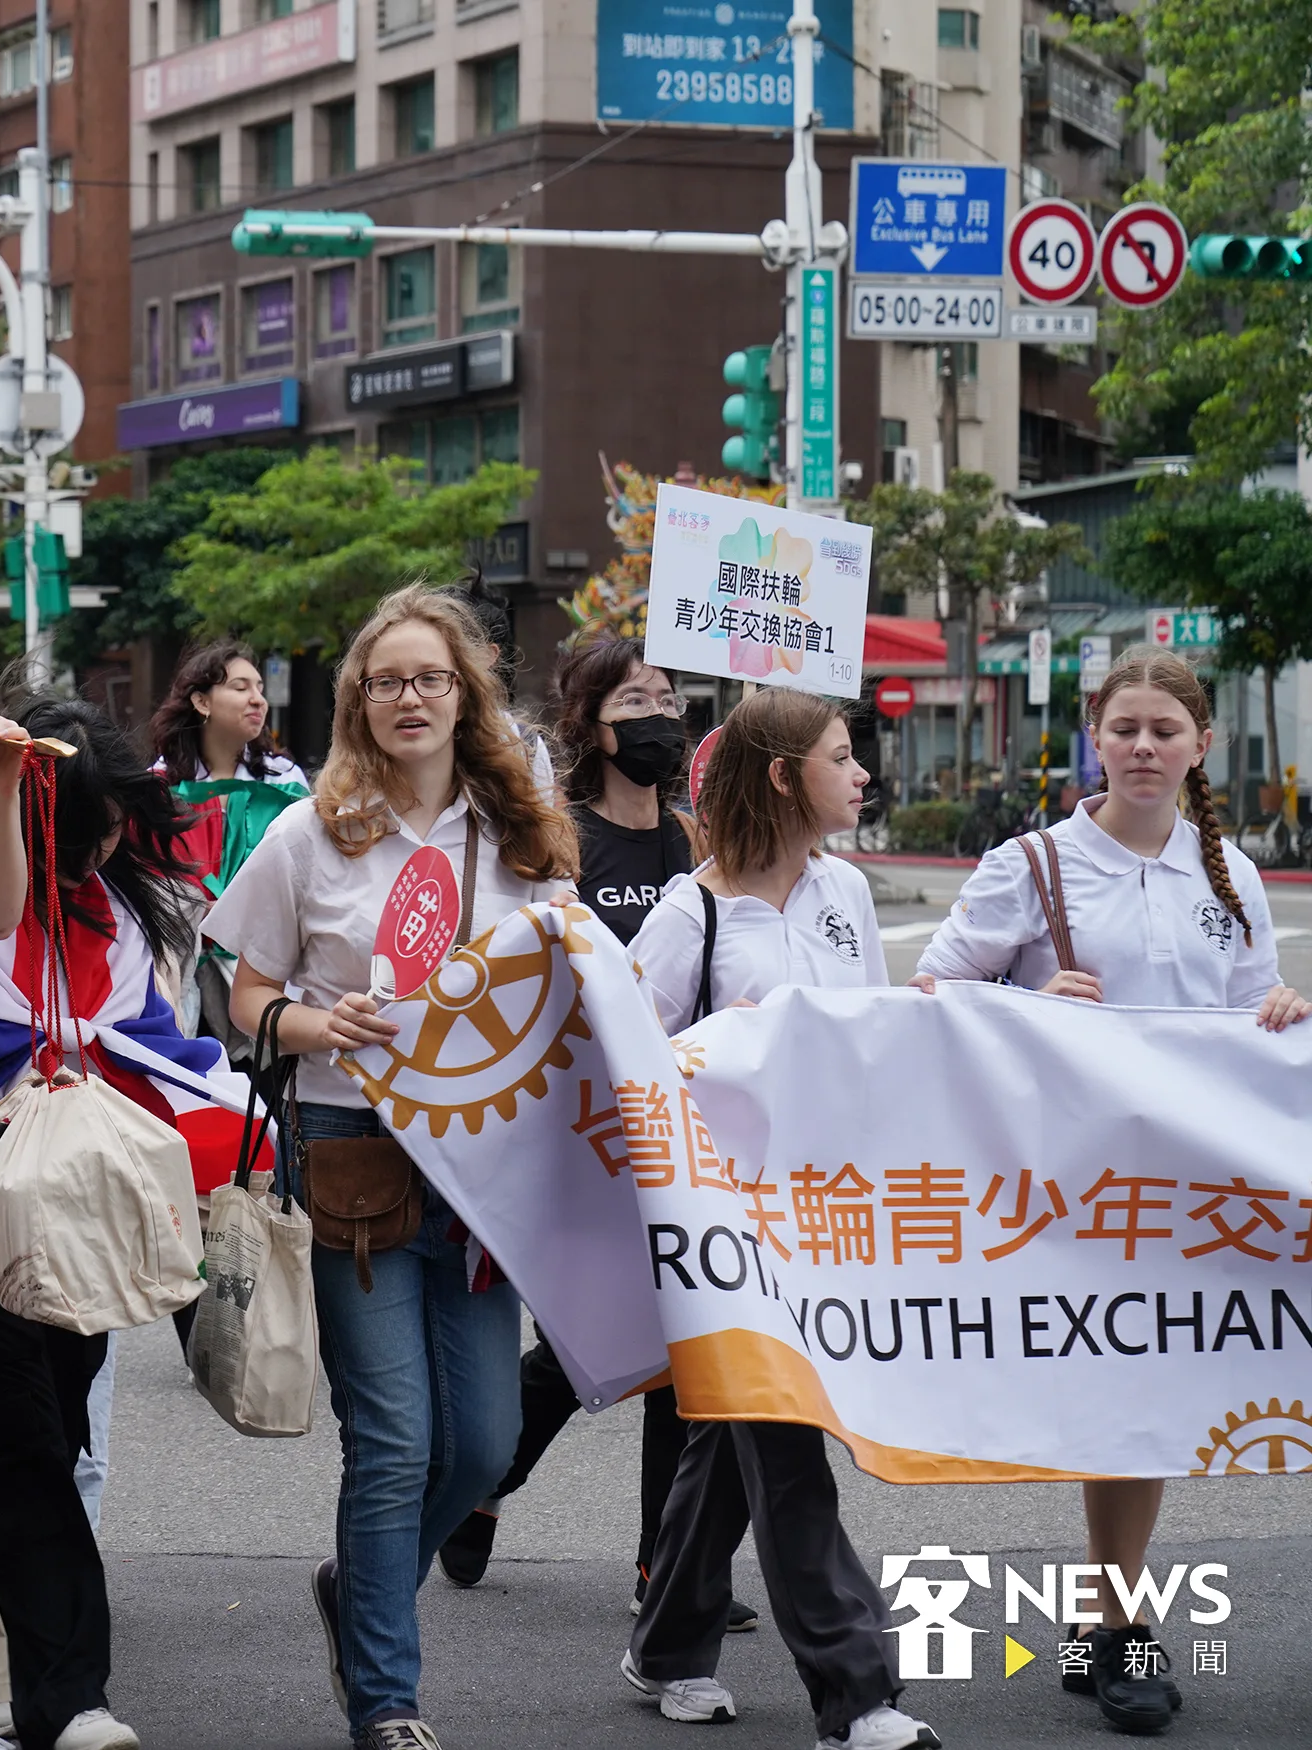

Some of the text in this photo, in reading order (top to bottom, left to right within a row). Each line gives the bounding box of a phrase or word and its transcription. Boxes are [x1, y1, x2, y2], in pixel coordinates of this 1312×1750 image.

[623, 33, 726, 61] 到站即到家
[656, 70, 793, 105] 23958588
[872, 197, 990, 228] 公車專用
[870, 225, 989, 244] Exclusive Bus Lane
[1028, 239, 1075, 269] 40
[835, 559, 863, 577] SDGs
[717, 561, 802, 607] 國際扶輪
[675, 598, 835, 654] 青少年交換協會1
[830, 663, 852, 681] 1-10
